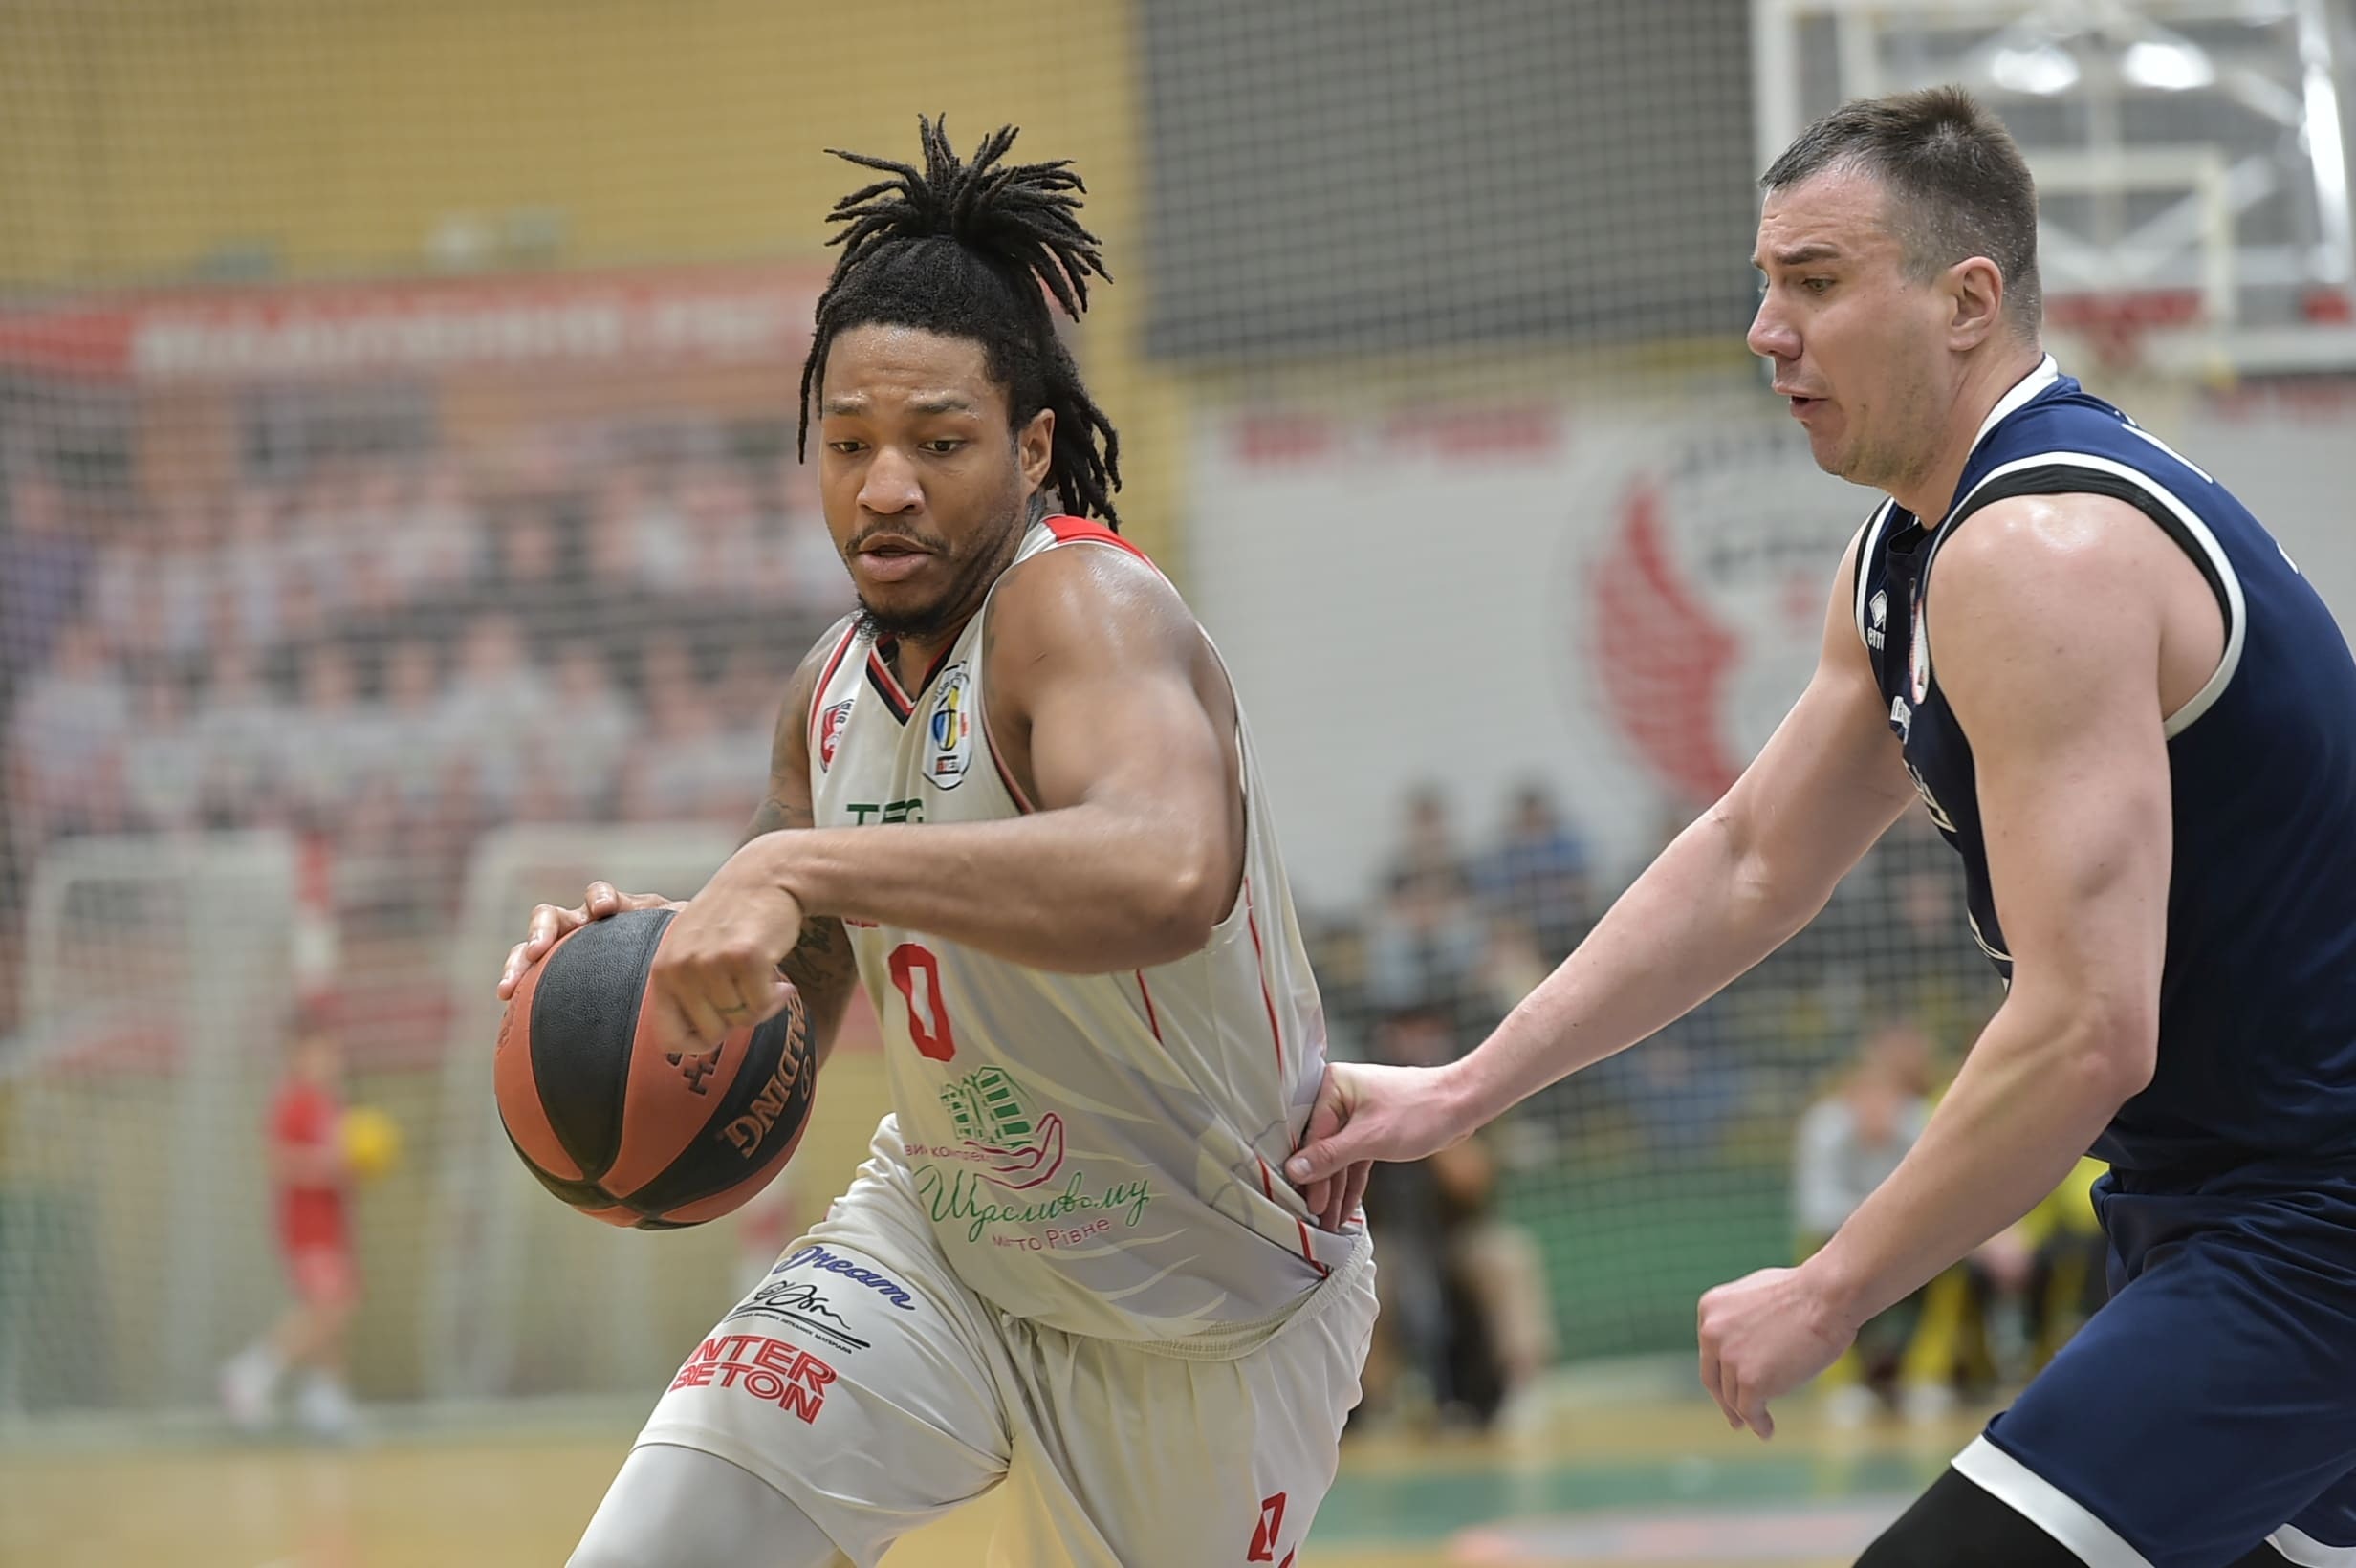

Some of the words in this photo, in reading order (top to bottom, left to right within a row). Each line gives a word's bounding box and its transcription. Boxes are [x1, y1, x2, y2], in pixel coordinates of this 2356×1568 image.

[888, 943, 955, 1062] 0
[771, 1245, 916, 1311] Dream
[668, 1361, 824, 1426] BETON
